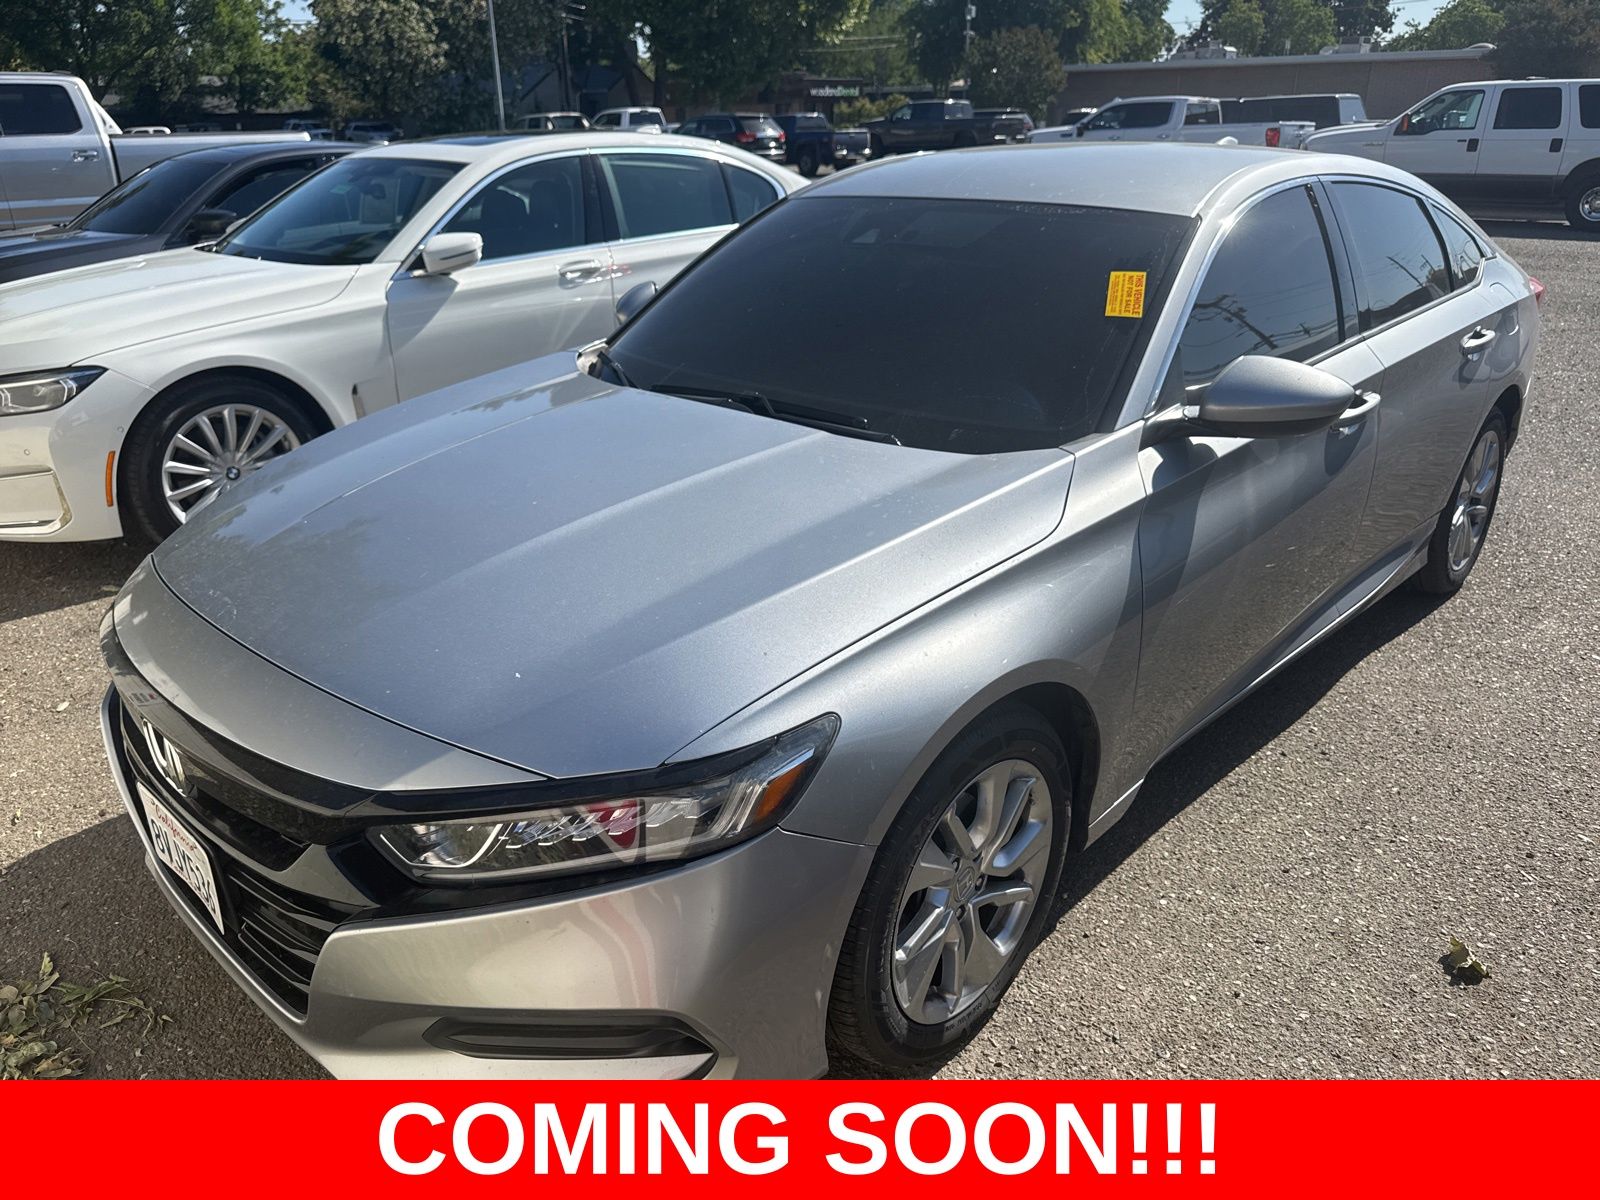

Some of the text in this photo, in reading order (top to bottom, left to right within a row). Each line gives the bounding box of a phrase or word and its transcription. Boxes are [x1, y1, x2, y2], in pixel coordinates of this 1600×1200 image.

[1123, 275, 1135, 314] NOT FOR SALE
[1131, 274, 1144, 316] THIS VEHICLE
[155, 803, 198, 851] California
